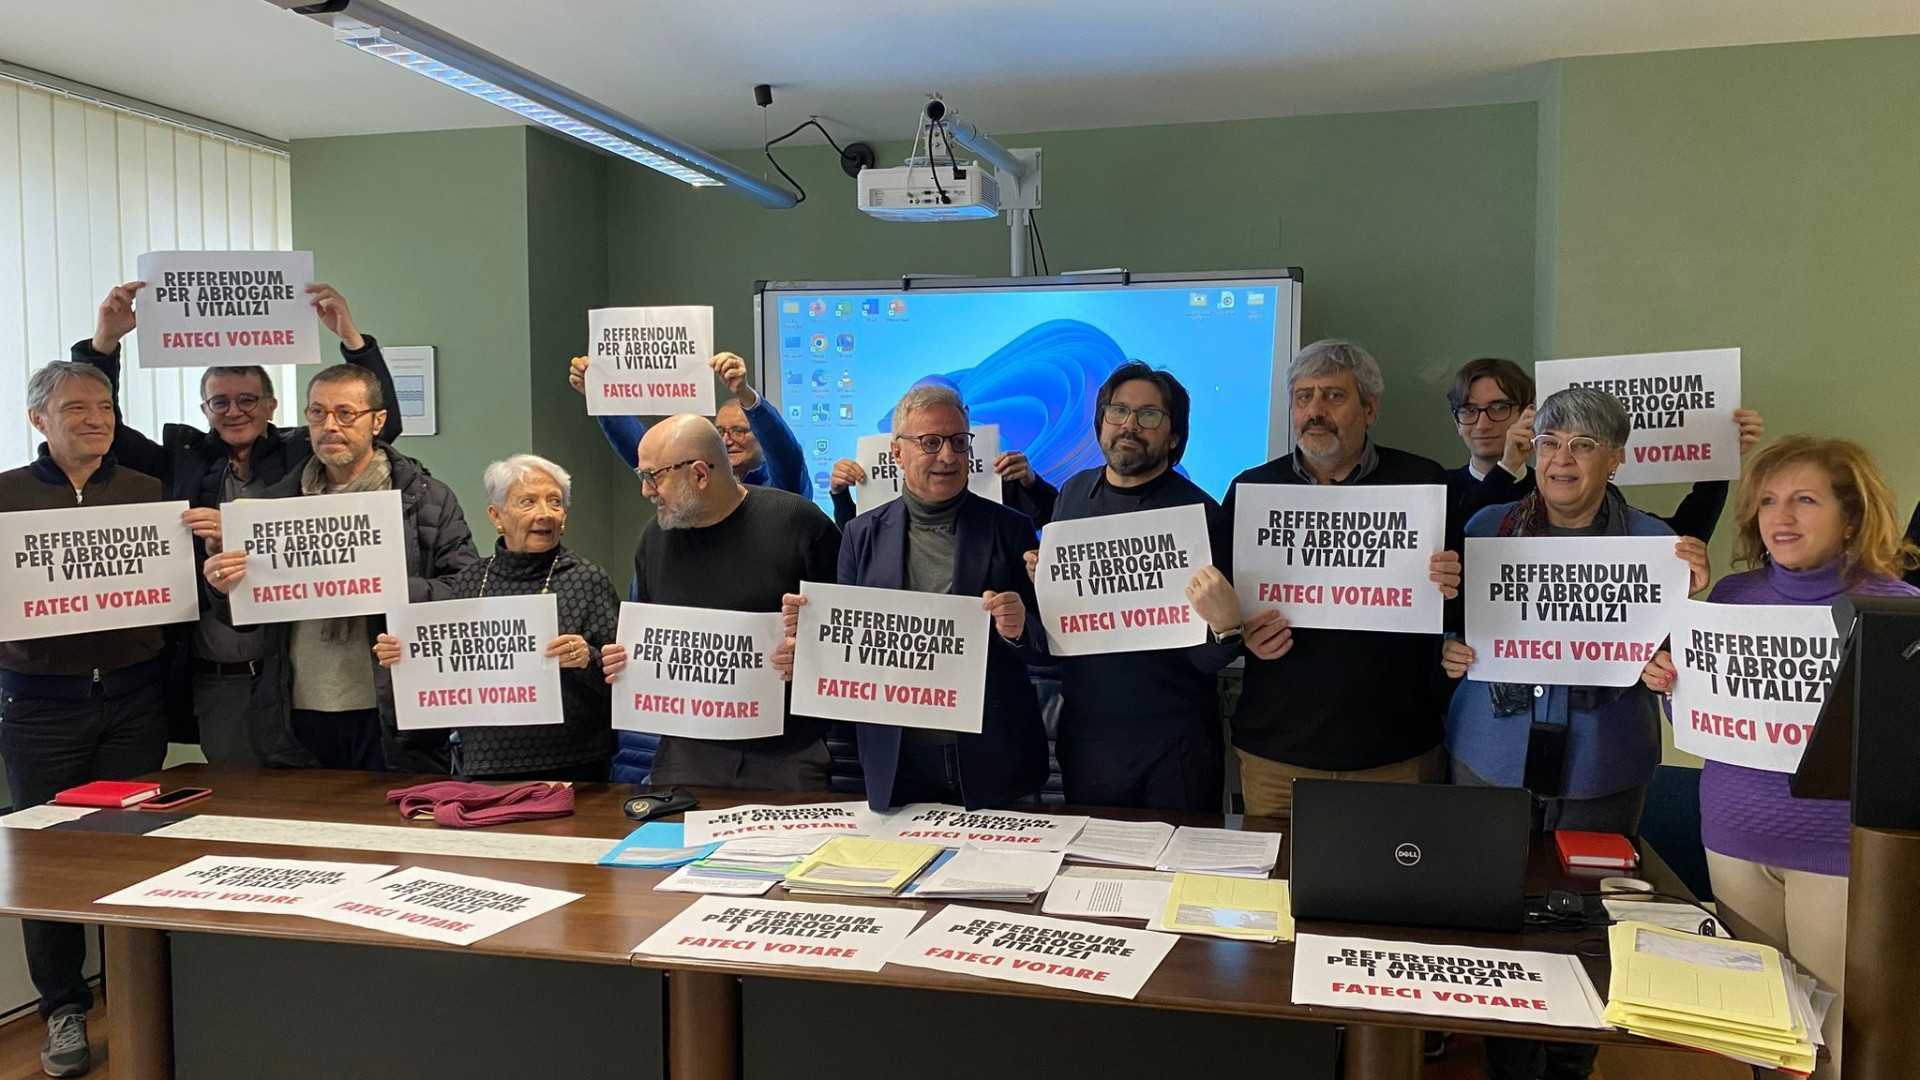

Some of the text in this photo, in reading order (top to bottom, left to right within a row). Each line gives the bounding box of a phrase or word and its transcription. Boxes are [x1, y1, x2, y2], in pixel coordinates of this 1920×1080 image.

[164, 271, 284, 287] REFERENDUM
[156, 285, 294, 302] PER ABROGARE
[184, 300, 269, 317] I VITALIZI
[163, 330, 294, 348] FATECI VOTARE
[603, 326, 687, 342] REFERENDUM
[598, 341, 695, 356] PER ABROGARE
[616, 355, 677, 370] I VITALIZI
[603, 383, 696, 397] FATECI VOTARE
[1622, 391, 1715, 413] BROGARE
[1634, 443, 1711, 464] VOTARE
[871, 465, 898, 480] PER
[894, 479, 898, 492] I
[253, 514, 370, 539] REFERENDUM
[1269, 510, 1407, 531] REFERENDUM
[24, 525, 159, 551] REFERENDUM
[244, 529, 381, 557] PER ABROGARE
[1056, 533, 1176, 564] REFERENDUM
[1257, 528, 1418, 549] PER ABROGARE
[15, 540, 170, 568] PER ABROGARE
[271, 547, 355, 569] I VITALIZI
[1287, 547, 1386, 568] I VITALIZI
[47, 558, 143, 582] I VITALIZI
[1050, 550, 1189, 582] PER ABROGARE
[1501, 564, 1648, 584] REFERENDUM
[253, 577, 381, 603] FATECI VOTARE
[1076, 571, 1164, 597] I VITALIZI
[1259, 583, 1412, 607] FATECI VOTARE
[1490, 583, 1661, 603] PER ABROGARE
[24, 587, 171, 617] FATECI VOTARE
[1521, 602, 1627, 622] I VITALIZI
[416, 619, 527, 641] REFERENDUM
[830, 608, 955, 637] REFERENDUM
[1060, 605, 1189, 633] FATECI VOTARE
[409, 635, 536, 658] PER ABROGARE
[643, 627, 753, 652] REFERENDUM
[819, 624, 965, 655] PER ABROGARE
[1494, 639, 1655, 662] FATECI VOTARE
[438, 653, 514, 673] I VITALIZI
[633, 643, 763, 669] PER ABROGARE
[845, 645, 935, 671] I VITALIZI
[1685, 648, 1837, 681] PER ABROGA
[656, 662, 735, 685] I VITALIZI
[1711, 674, 1718, 695] I
[418, 686, 537, 707] FATECI VOTARE
[818, 678, 957, 707] FATECI VOTARE
[635, 694, 759, 718] FATECI VOTARE
[1691, 709, 1757, 741] FATECI
[927, 810, 1051, 825] REFERENDUM
[949, 821, 1026, 832] VITALIZI
[955, 816, 1059, 830] ABROGARE
[712, 822, 858, 838] FATECI VOTARE
[899, 831, 1043, 844] FATECI VOTARE
[1398, 850, 1418, 858] DELL
[186, 870, 346, 886] PER ABROGARE
[210, 865, 346, 878] REFERENDUM
[216, 878, 303, 889] VITALIZI
[407, 879, 531, 904] REFERENDUM
[144, 889, 303, 905] FATECI VOTARE
[382, 883, 527, 913] PER ABROGARE
[403, 895, 483, 914] VITALIZI
[333, 901, 475, 932] FATECI VOTARE
[701, 914, 884, 934] PER ABROGARE
[721, 907, 876, 925] REFERENDUM
[726, 924, 842, 940] I VITALIZI
[948, 924, 1135, 957] PER ABROGARE
[968, 919, 1128, 948] REFERENDUM
[677, 936, 858, 958] FATECI VOTARE
[972, 936, 1092, 960] I VITALIZI
[924, 947, 1111, 982] FATECI VOTARE
[1327, 956, 1543, 982] PER ABROGARE
[1341, 948, 1524, 971] REFERENDUM
[1368, 968, 1503, 988] I VITALIZI
[1332, 982, 1548, 1011] FATECI VOTARE
